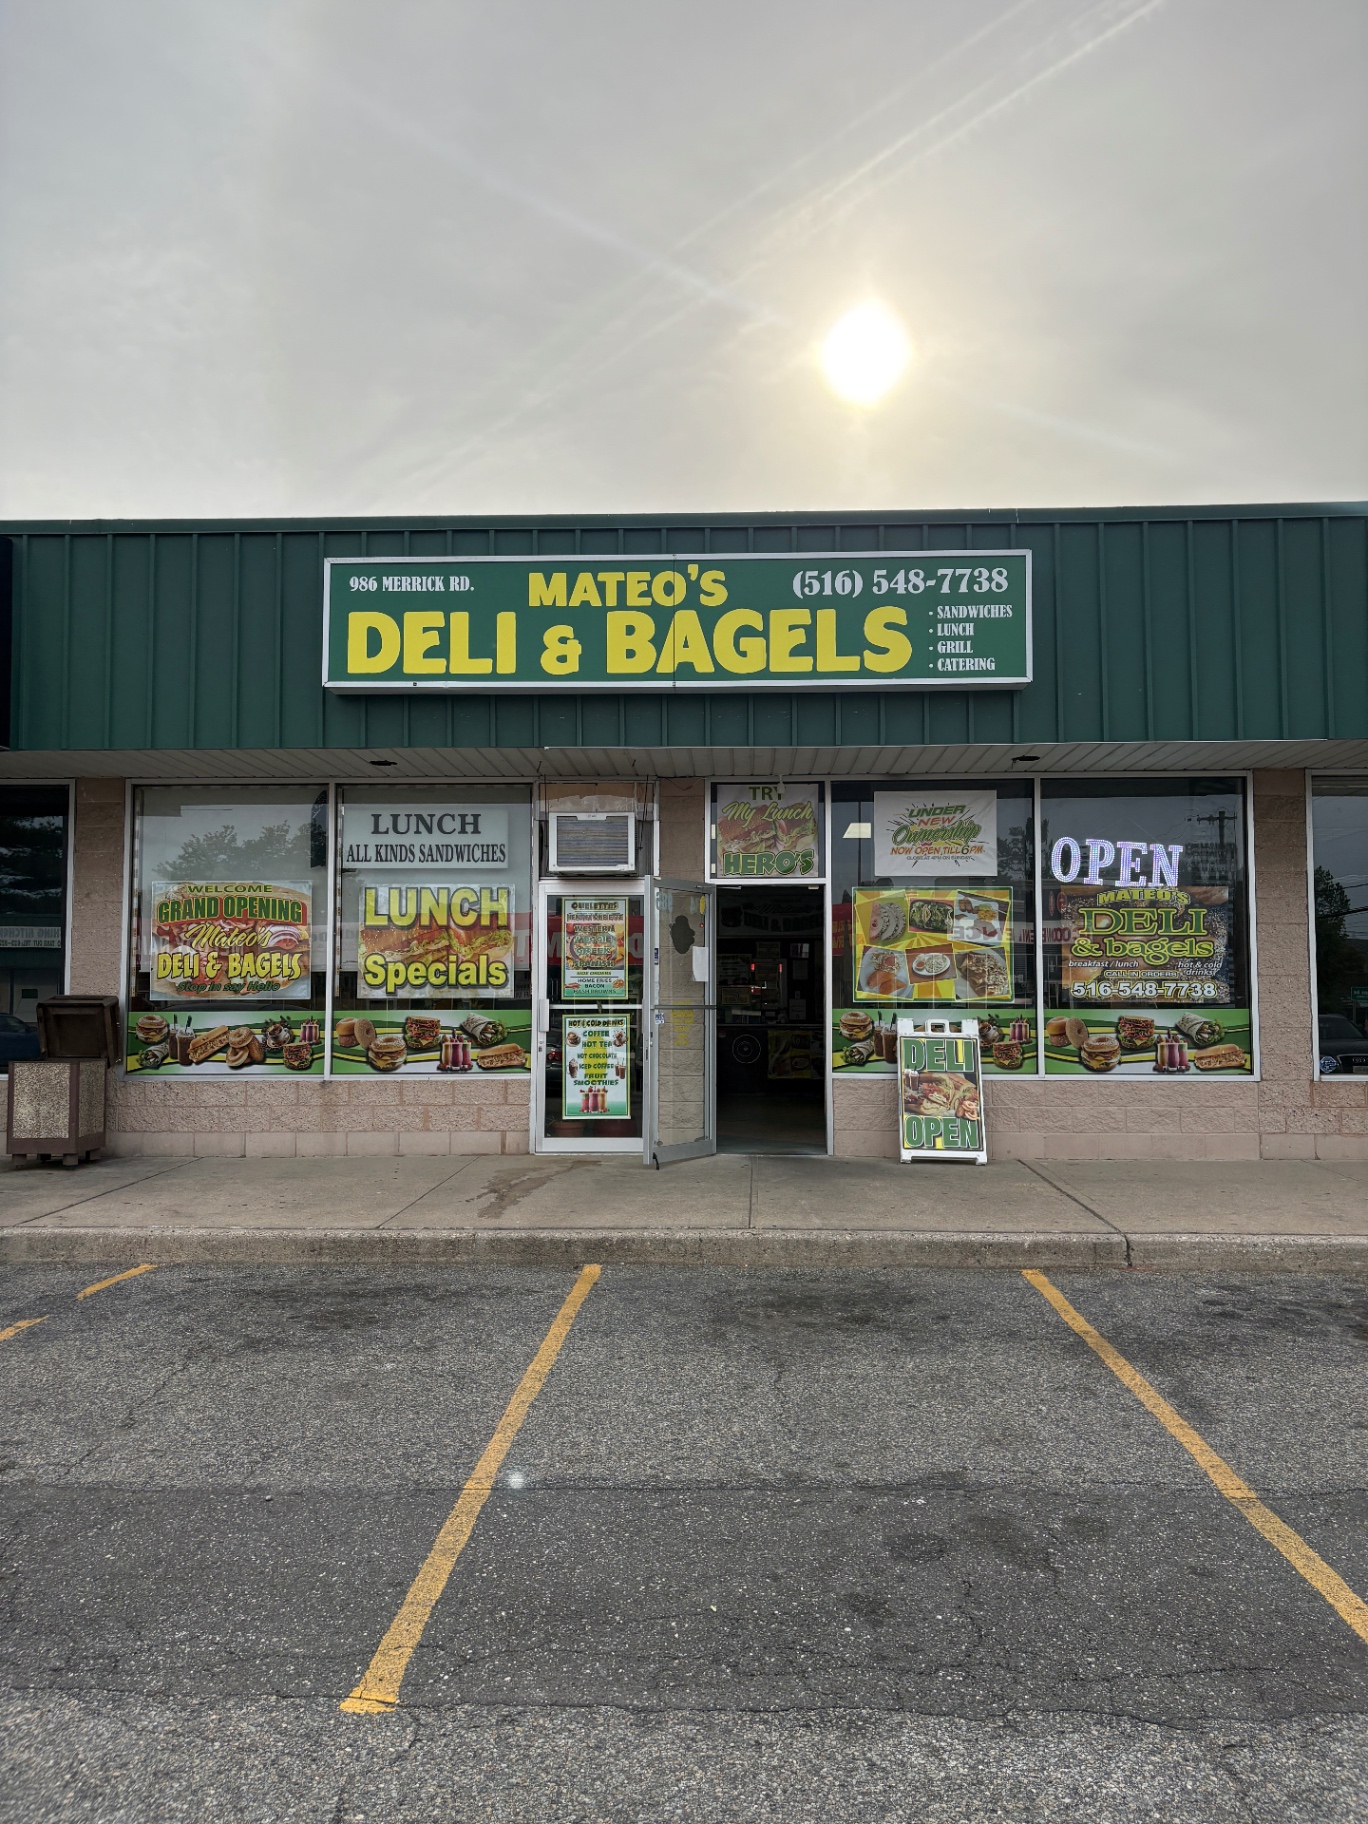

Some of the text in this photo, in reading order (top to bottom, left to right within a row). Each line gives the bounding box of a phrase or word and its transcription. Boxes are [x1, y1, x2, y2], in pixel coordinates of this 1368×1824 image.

[349, 576, 475, 592] 986 MERRICK RD.
[528, 564, 728, 607] MATEO'S
[792, 568, 1009, 599] (516) 548-7738
[937, 604, 1012, 618] SANDWICHES
[937, 623, 975, 636] LUNCH
[347, 605, 913, 676] DELI & BAGELS
[937, 641, 974, 654] GRILL
[937, 658, 996, 672] CATERING
[749, 786, 786, 801] TRY
[722, 801, 813, 828] My Lunch
[908, 805, 966, 818] UNDER
[917, 816, 955, 827] NEW
[371, 813, 482, 835] LUNCH
[891, 820, 982, 846] Ownership
[346, 843, 506, 864] ALL KINDS SANDWICHES
[890, 847, 912, 855] NOW
[914, 847, 941, 855] OPEN
[942, 847, 961, 855] TILL
[1051, 836, 1183, 887] OPEN
[723, 848, 814, 876] HERO'S
[187, 884, 273, 893] WELCOME
[1097, 888, 1191, 906] MATEO'S
[157, 896, 304, 924] GRAND OPENING
[364, 886, 510, 929] LUNCH
[1078, 908, 1208, 936] DELI
[1071, 937, 1215, 966] & bagels
[157, 951, 303, 980] DELI & BAGELS
[363, 953, 509, 994] Specials
[1068, 960, 1109, 968] breakfast
[1115, 960, 1139, 968] lunch
[1178, 960, 1223, 969] hot & cold
[177, 981, 281, 995] Stop in say Hello
[1072, 982, 1217, 998] 516-548-7738
[903, 1039, 974, 1073] DELI
[904, 1116, 979, 1150] OPEN
